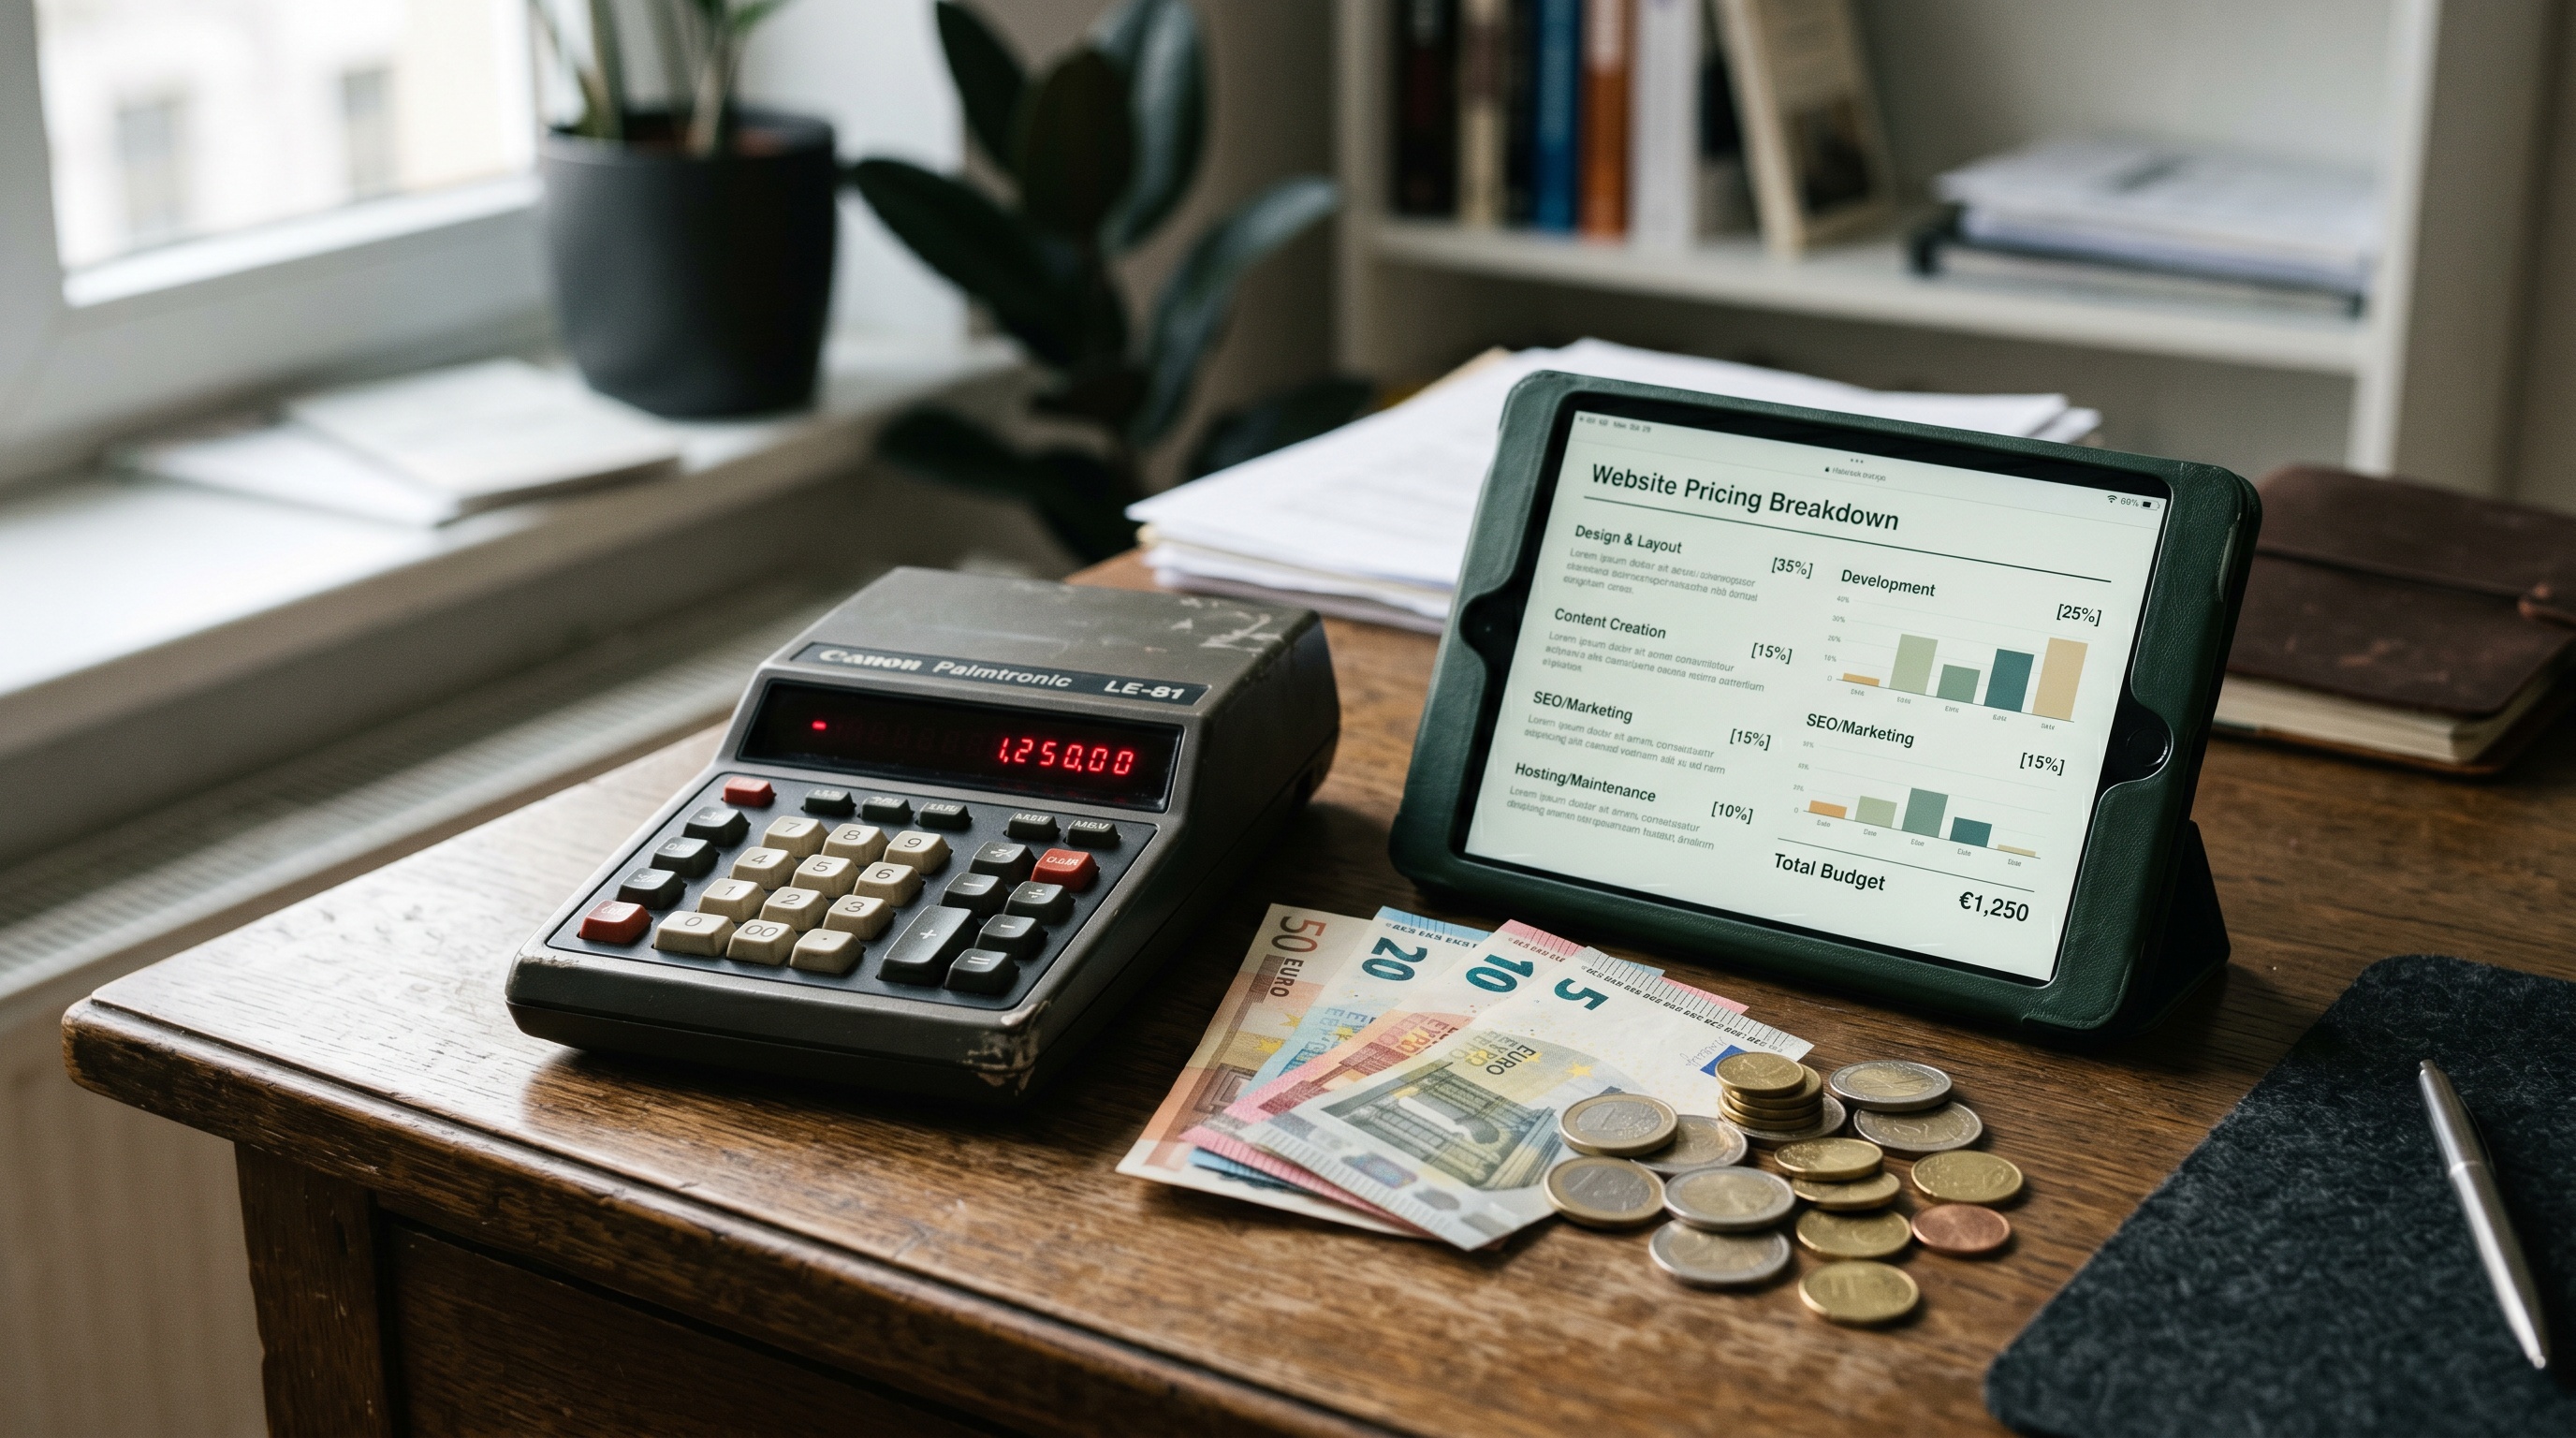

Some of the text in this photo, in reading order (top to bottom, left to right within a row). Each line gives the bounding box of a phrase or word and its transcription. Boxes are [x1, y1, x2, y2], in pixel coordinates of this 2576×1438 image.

[1592, 463, 1899, 531] Website Pricing Breakdown
[1575, 525, 1682, 554] Design & Layout
[1772, 557, 1813, 579] [35%]
[1841, 569, 1936, 597] Development
[1555, 609, 1666, 639] Content Creation
[2056, 604, 2101, 626] [25%]
[1751, 642, 1793, 664] [15%]
[820, 650, 1184, 700] Canon Palmtronic LE-81
[1533, 691, 1632, 724] SEO/Marketing
[1730, 728, 1771, 751] [15%]
[1807, 713, 1914, 748] SEO/Marketing
[2020, 753, 2065, 776] [15%]
[1515, 762, 1656, 802] Hosting/Maintenance
[1711, 801, 1753, 824] [10%]
[788, 822, 801, 832] 7
[842, 829, 860, 840] 8
[904, 838, 922, 848] 9
[752, 854, 768, 865] 4
[812, 859, 828, 871] 5
[875, 868, 894, 879] 6
[1775, 853, 1885, 890] Total Budget
[724, 886, 737, 896] 1
[780, 894, 798, 904] 2
[844, 901, 864, 913] 3
[1959, 892, 2029, 922] €1,250
[684, 917, 702, 927] 0
[744, 925, 778, 936] 00
[1269, 916, 1326, 997] 50 EURO
[1362, 937, 1427, 981] 20
[1466, 954, 1533, 992] 10
[1554, 977, 1609, 1011] 5
[1486, 1044, 1536, 1075] EURO
